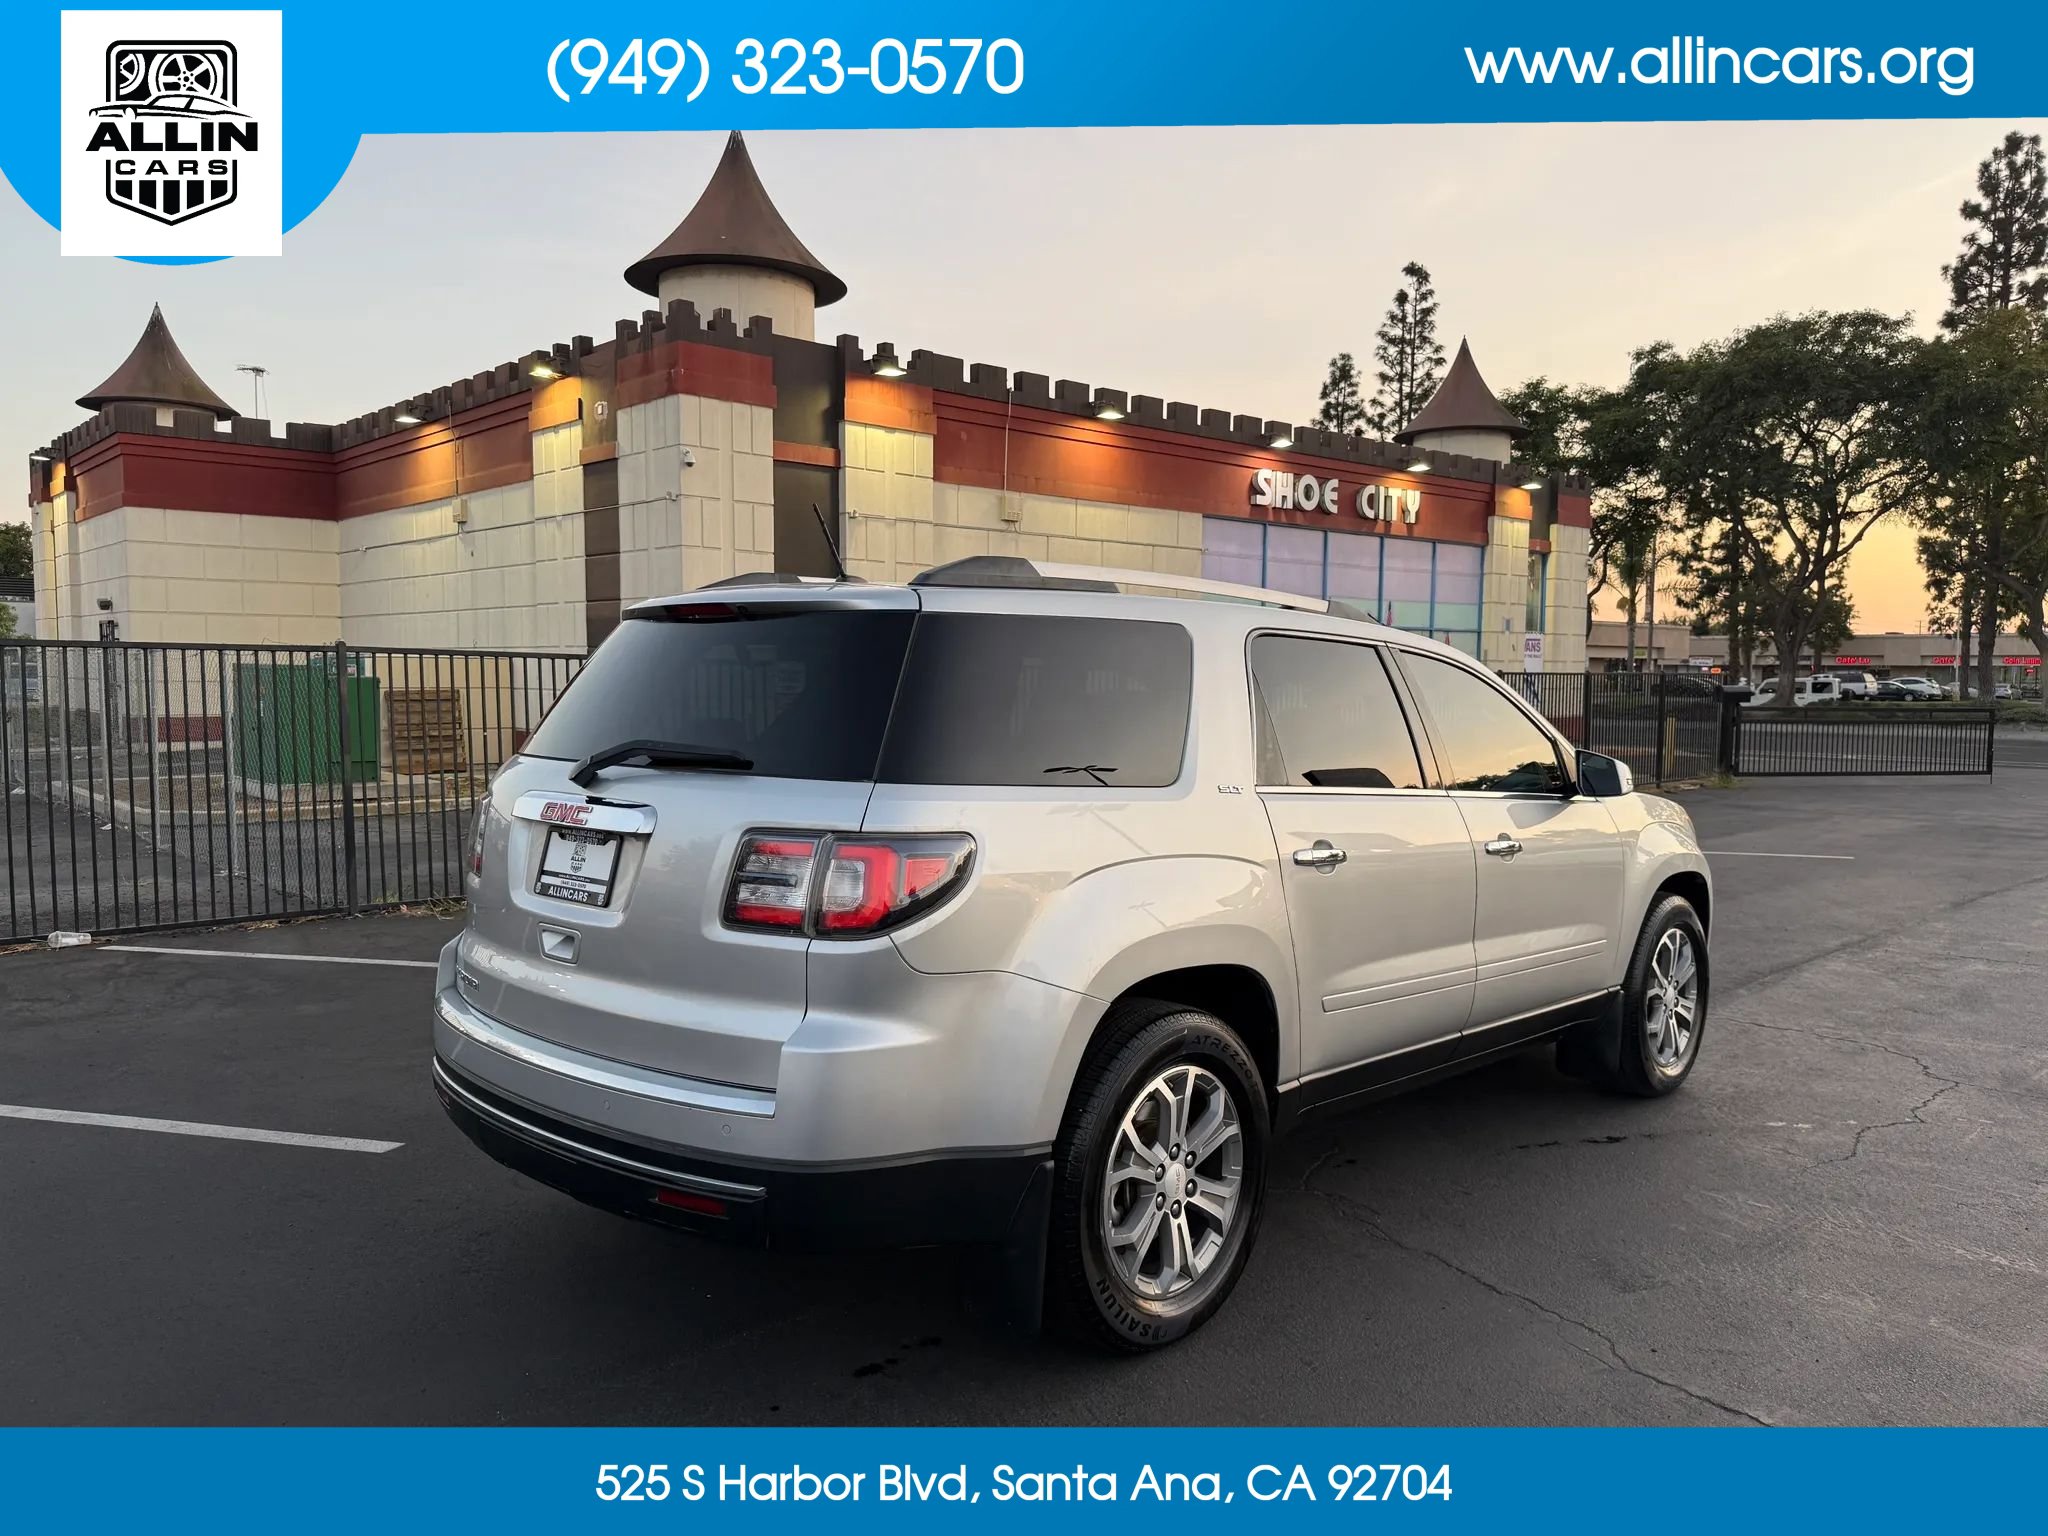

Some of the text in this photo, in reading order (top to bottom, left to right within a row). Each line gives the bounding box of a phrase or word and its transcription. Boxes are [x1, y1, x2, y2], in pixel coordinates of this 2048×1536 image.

[1250, 468, 1421, 524] SHOE CITY
[540, 802, 593, 825] GMC
[547, 885, 589, 902] ALLINCARS
[1191, 1034, 1254, 1080] ATREZZO
[1096, 1279, 1152, 1337] SAILUN
